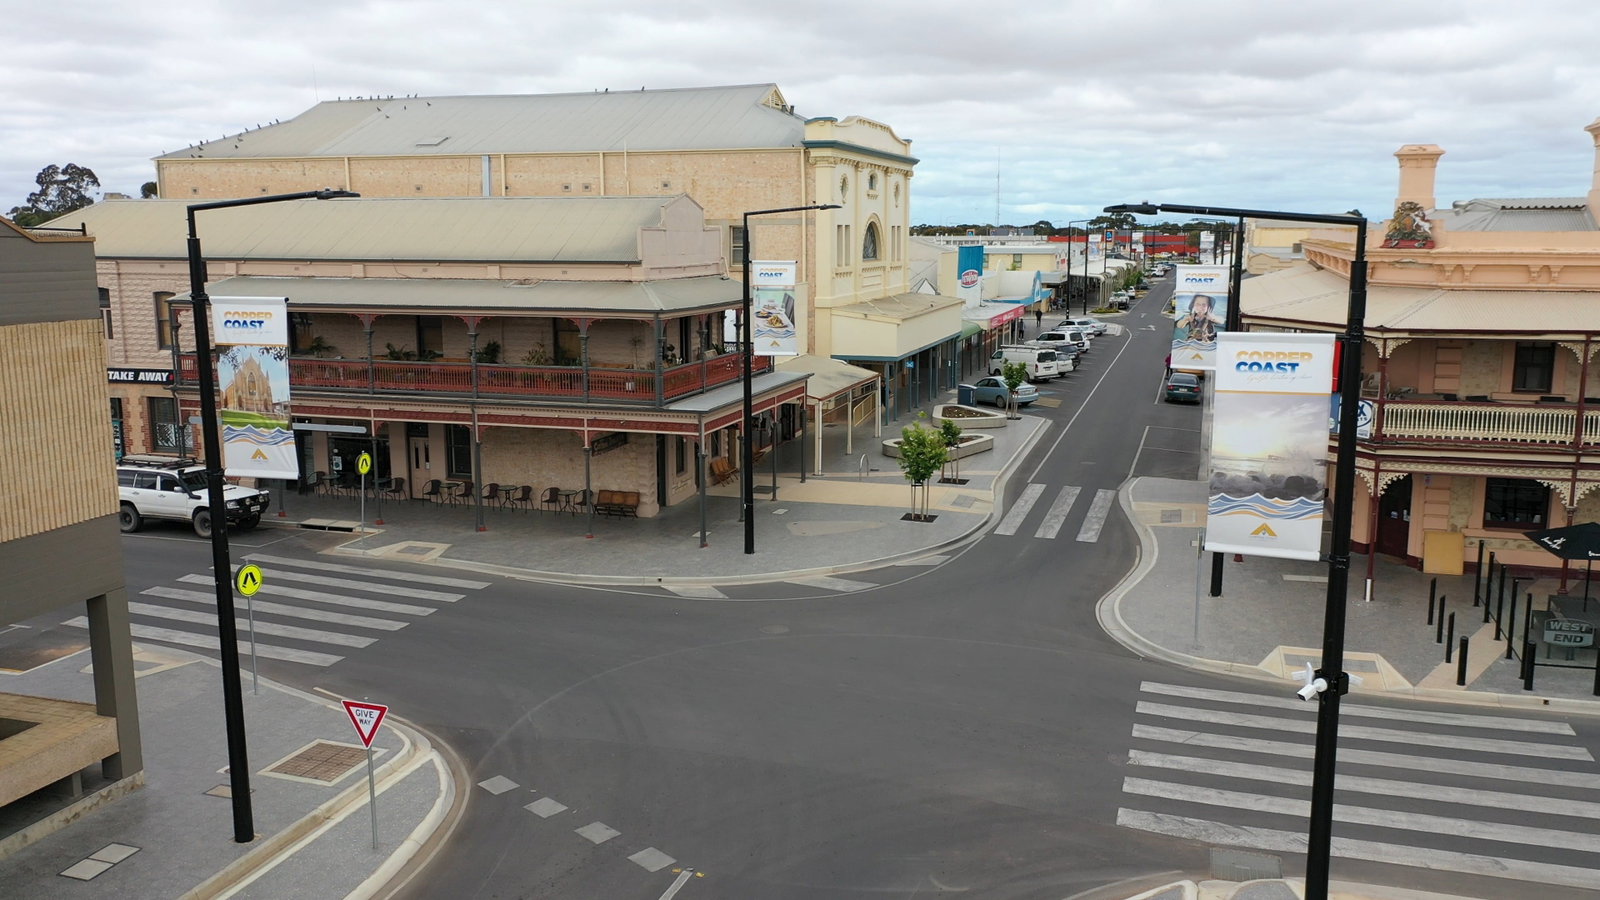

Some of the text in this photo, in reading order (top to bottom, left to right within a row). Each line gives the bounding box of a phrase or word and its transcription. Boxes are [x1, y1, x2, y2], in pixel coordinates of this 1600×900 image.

[223, 319, 265, 329] COAST
[1235, 361, 1299, 374] COAST
[108, 371, 169, 382] TAKE AWAY
[1550, 621, 1589, 632] WEST
[1553, 633, 1584, 643] END
[355, 709, 375, 719] GIVE
